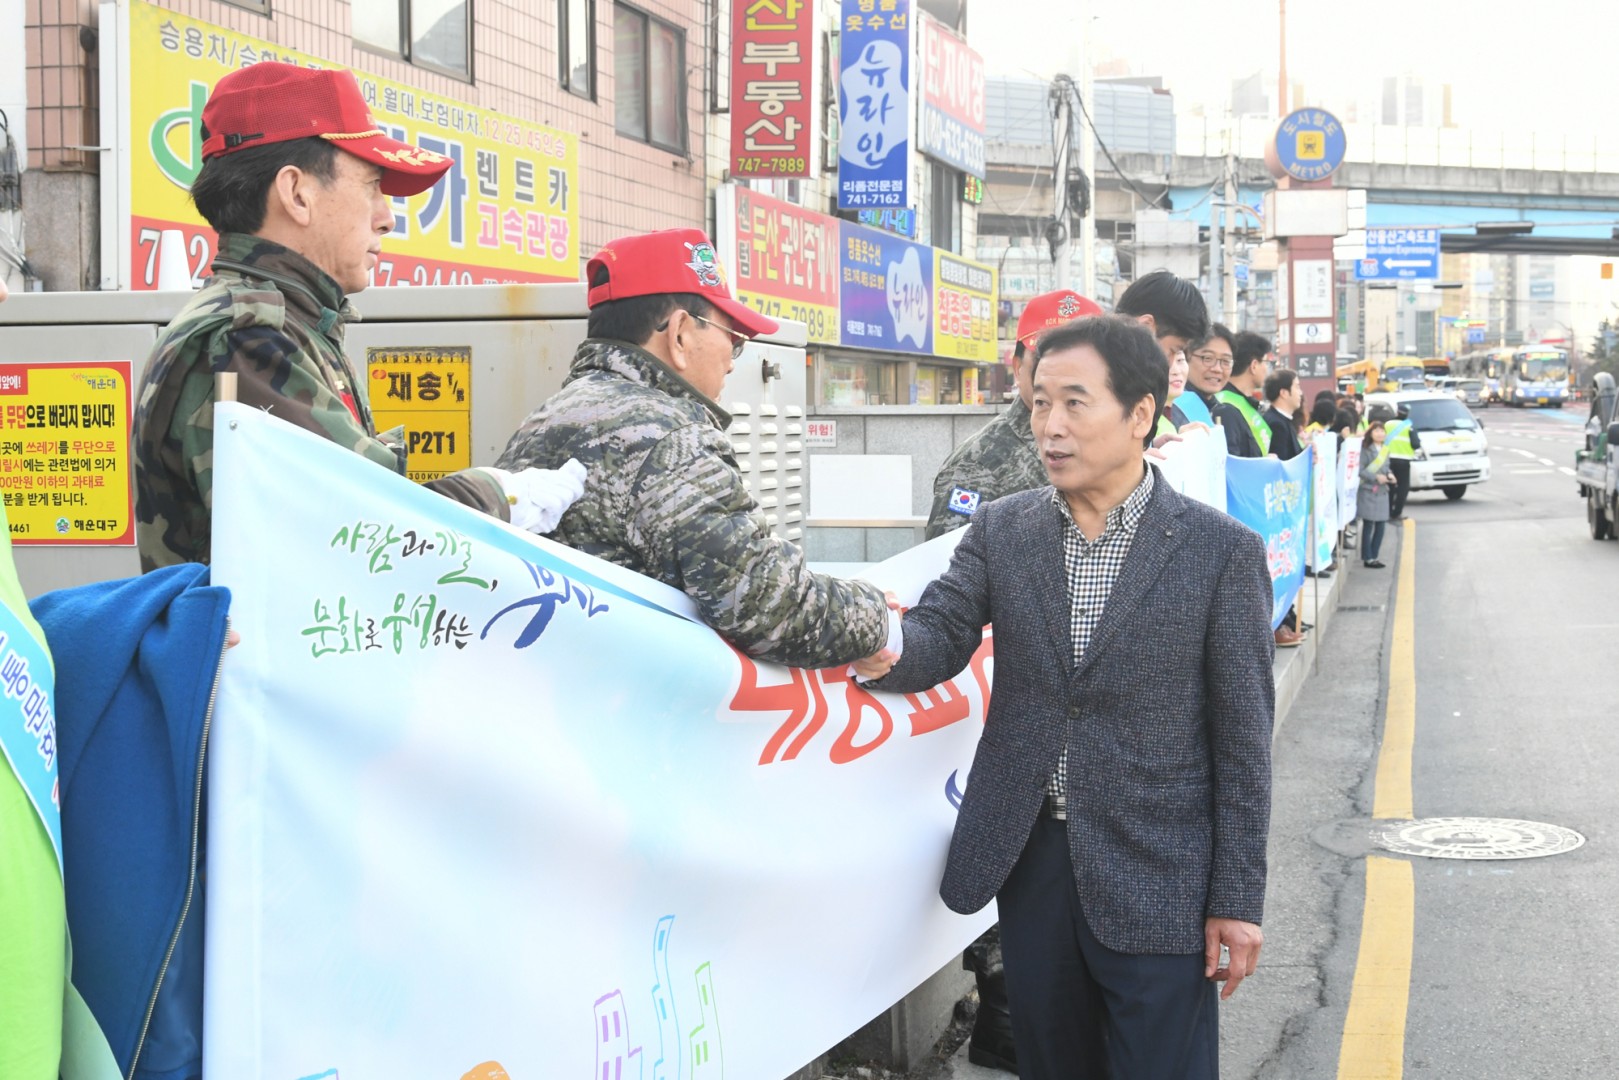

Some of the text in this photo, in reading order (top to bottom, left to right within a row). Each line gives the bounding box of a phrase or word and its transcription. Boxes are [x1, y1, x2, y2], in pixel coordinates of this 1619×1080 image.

[845, 14, 907, 31] 옷수선
[742, 41, 803, 151] 부동산
[856, 44, 896, 166] 뉴라인
[1282, 111, 1339, 136] 도시철도
[737, 157, 806, 172] 747-7989
[1289, 161, 1333, 178] METRO
[476, 149, 568, 212] 렌트카
[843, 179, 904, 193] 리폼전문점
[847, 194, 900, 204] 741-7162
[477, 202, 569, 261] 고속관광
[1366, 230, 1437, 245] 산울산고속도로
[892, 272, 924, 323] 뉴라인
[0, 375, 21, 390] 앞에!
[387, 371, 441, 401] 재송
[7, 404, 46, 430] 무단으로
[49, 404, 79, 429] 버리지
[82, 403, 115, 428] 맙시다!
[808, 423, 833, 436] 위험!
[0, 441, 116, 455] 곳에 쓰레기를 무단으로
[409, 431, 455, 454] P2T1
[0, 457, 116, 472] 릴시에는 관련법에 의거
[37, 475, 68, 488] 이하의
[72, 475, 105, 488] 과태료
[28, 493, 49, 506] 받게
[52, 493, 88, 506] 됩니다.
[74, 519, 118, 531] 해운대구
